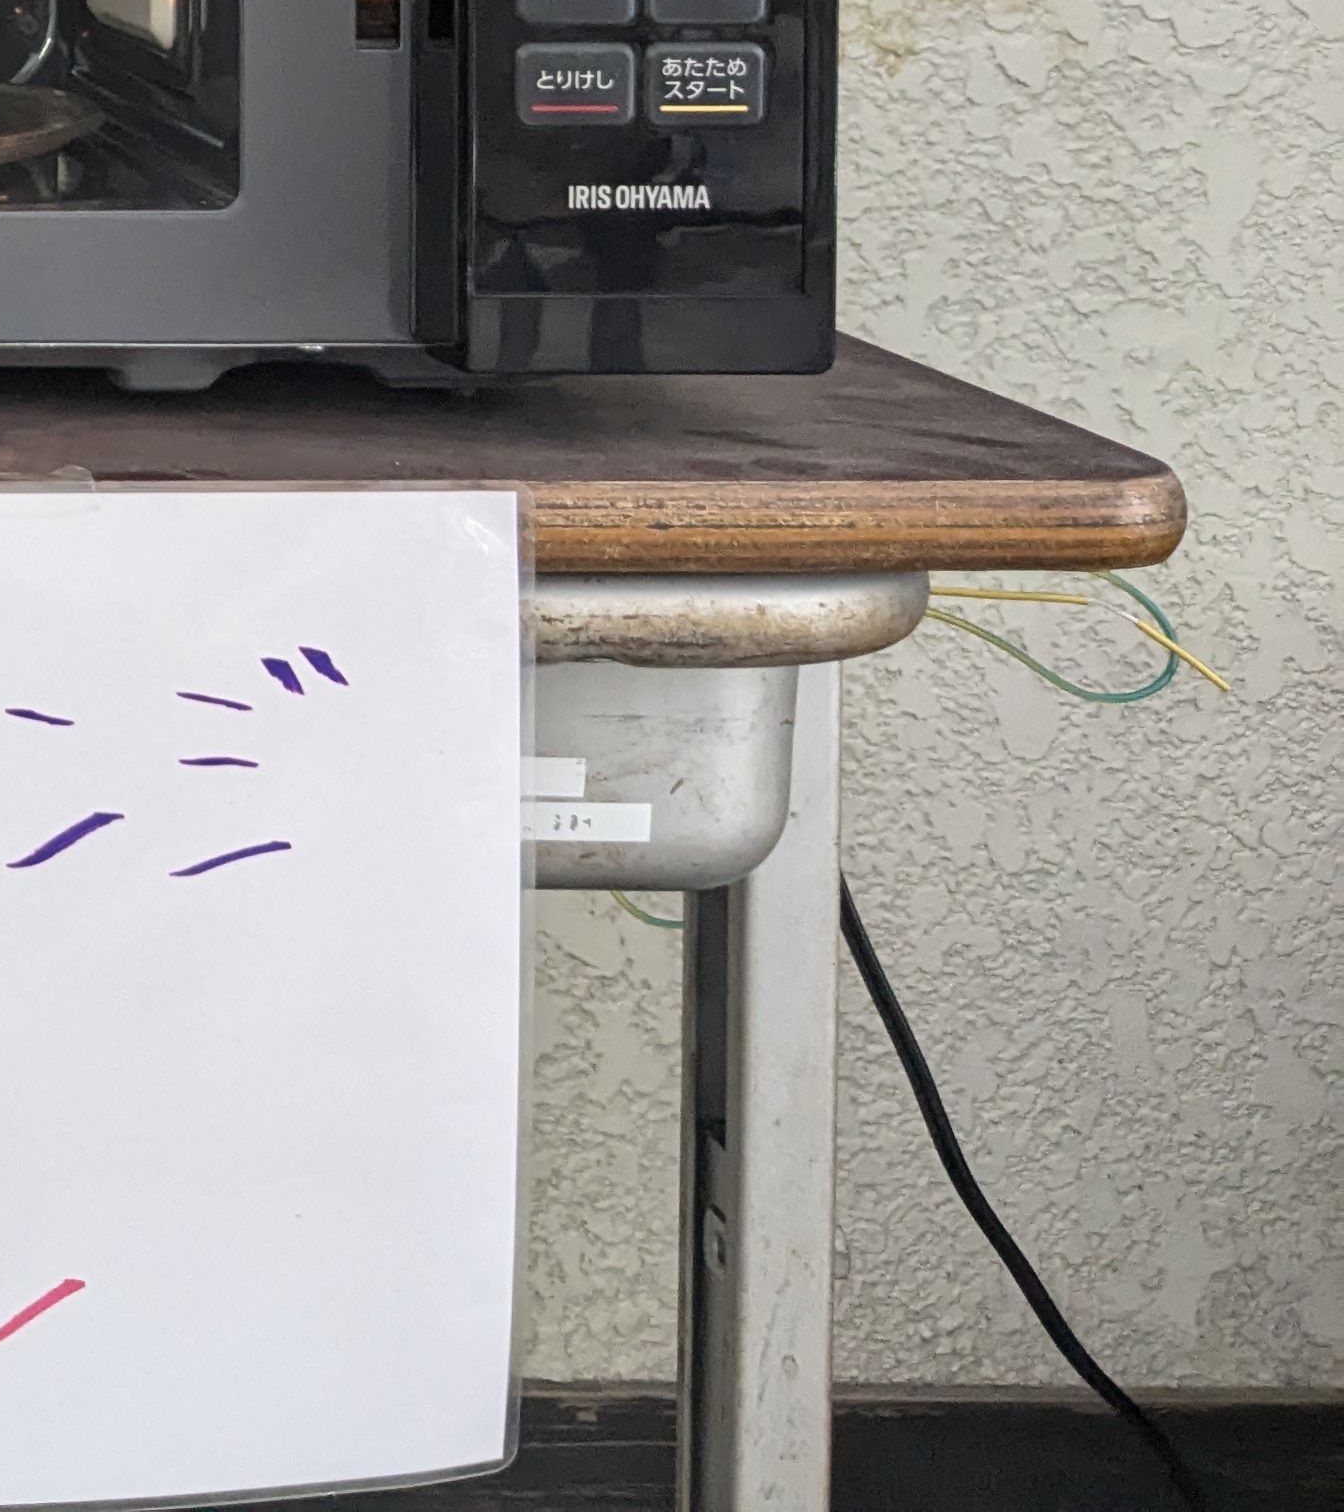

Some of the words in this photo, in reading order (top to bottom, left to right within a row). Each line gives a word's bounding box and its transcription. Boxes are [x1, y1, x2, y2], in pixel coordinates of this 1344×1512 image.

[662, 57, 747, 78] あたため
[536, 69, 614, 90] とりけし
[664, 79, 745, 100] スタート
[568, 185, 611, 209] IRIS
[615, 185, 711, 209] OHYAMA
